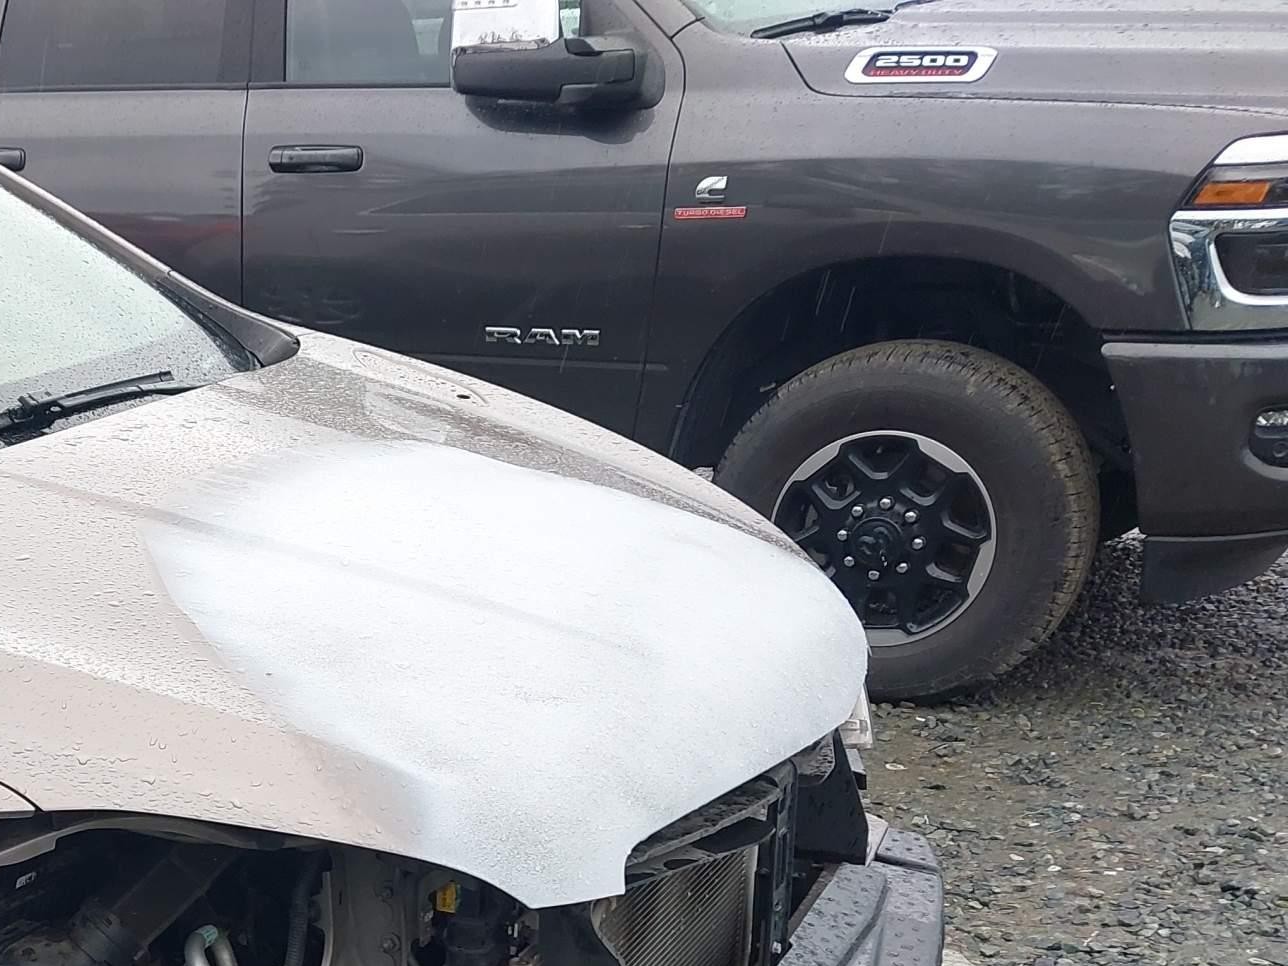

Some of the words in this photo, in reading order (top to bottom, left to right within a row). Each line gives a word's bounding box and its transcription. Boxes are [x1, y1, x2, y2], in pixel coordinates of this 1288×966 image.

[875, 54, 969, 67] 2500
[677, 208, 709, 217] TURBO
[709, 207, 745, 217] DIESEL
[485, 326, 600, 345] RAM
